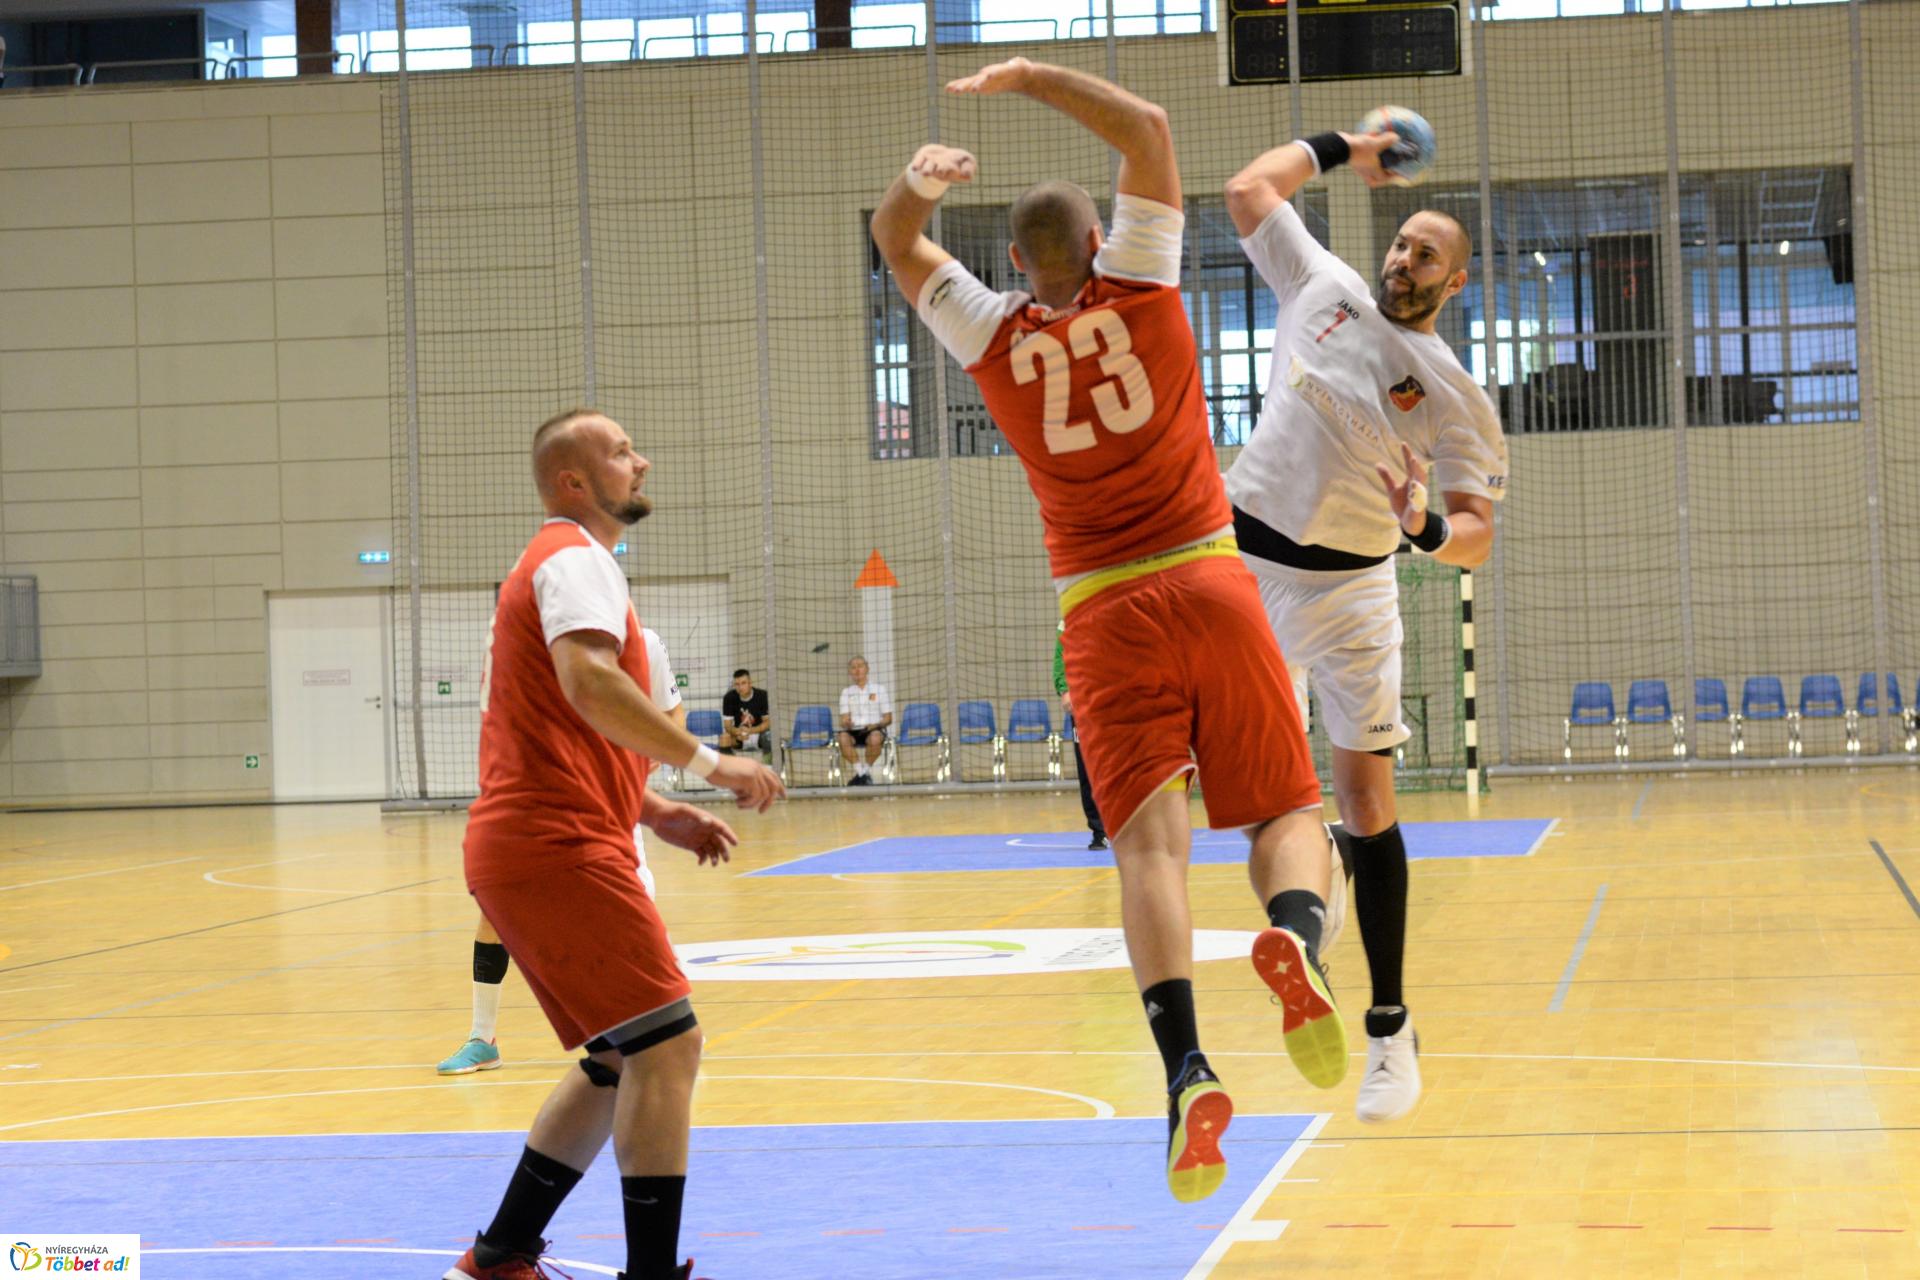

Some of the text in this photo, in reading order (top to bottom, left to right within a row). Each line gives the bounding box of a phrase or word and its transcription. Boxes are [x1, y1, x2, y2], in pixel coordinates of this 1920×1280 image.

[1337, 299, 1360, 320] JAKO
[1315, 310, 1349, 343] 7
[1010, 308, 1155, 455] 23
[1367, 723, 1394, 734] JAKO
